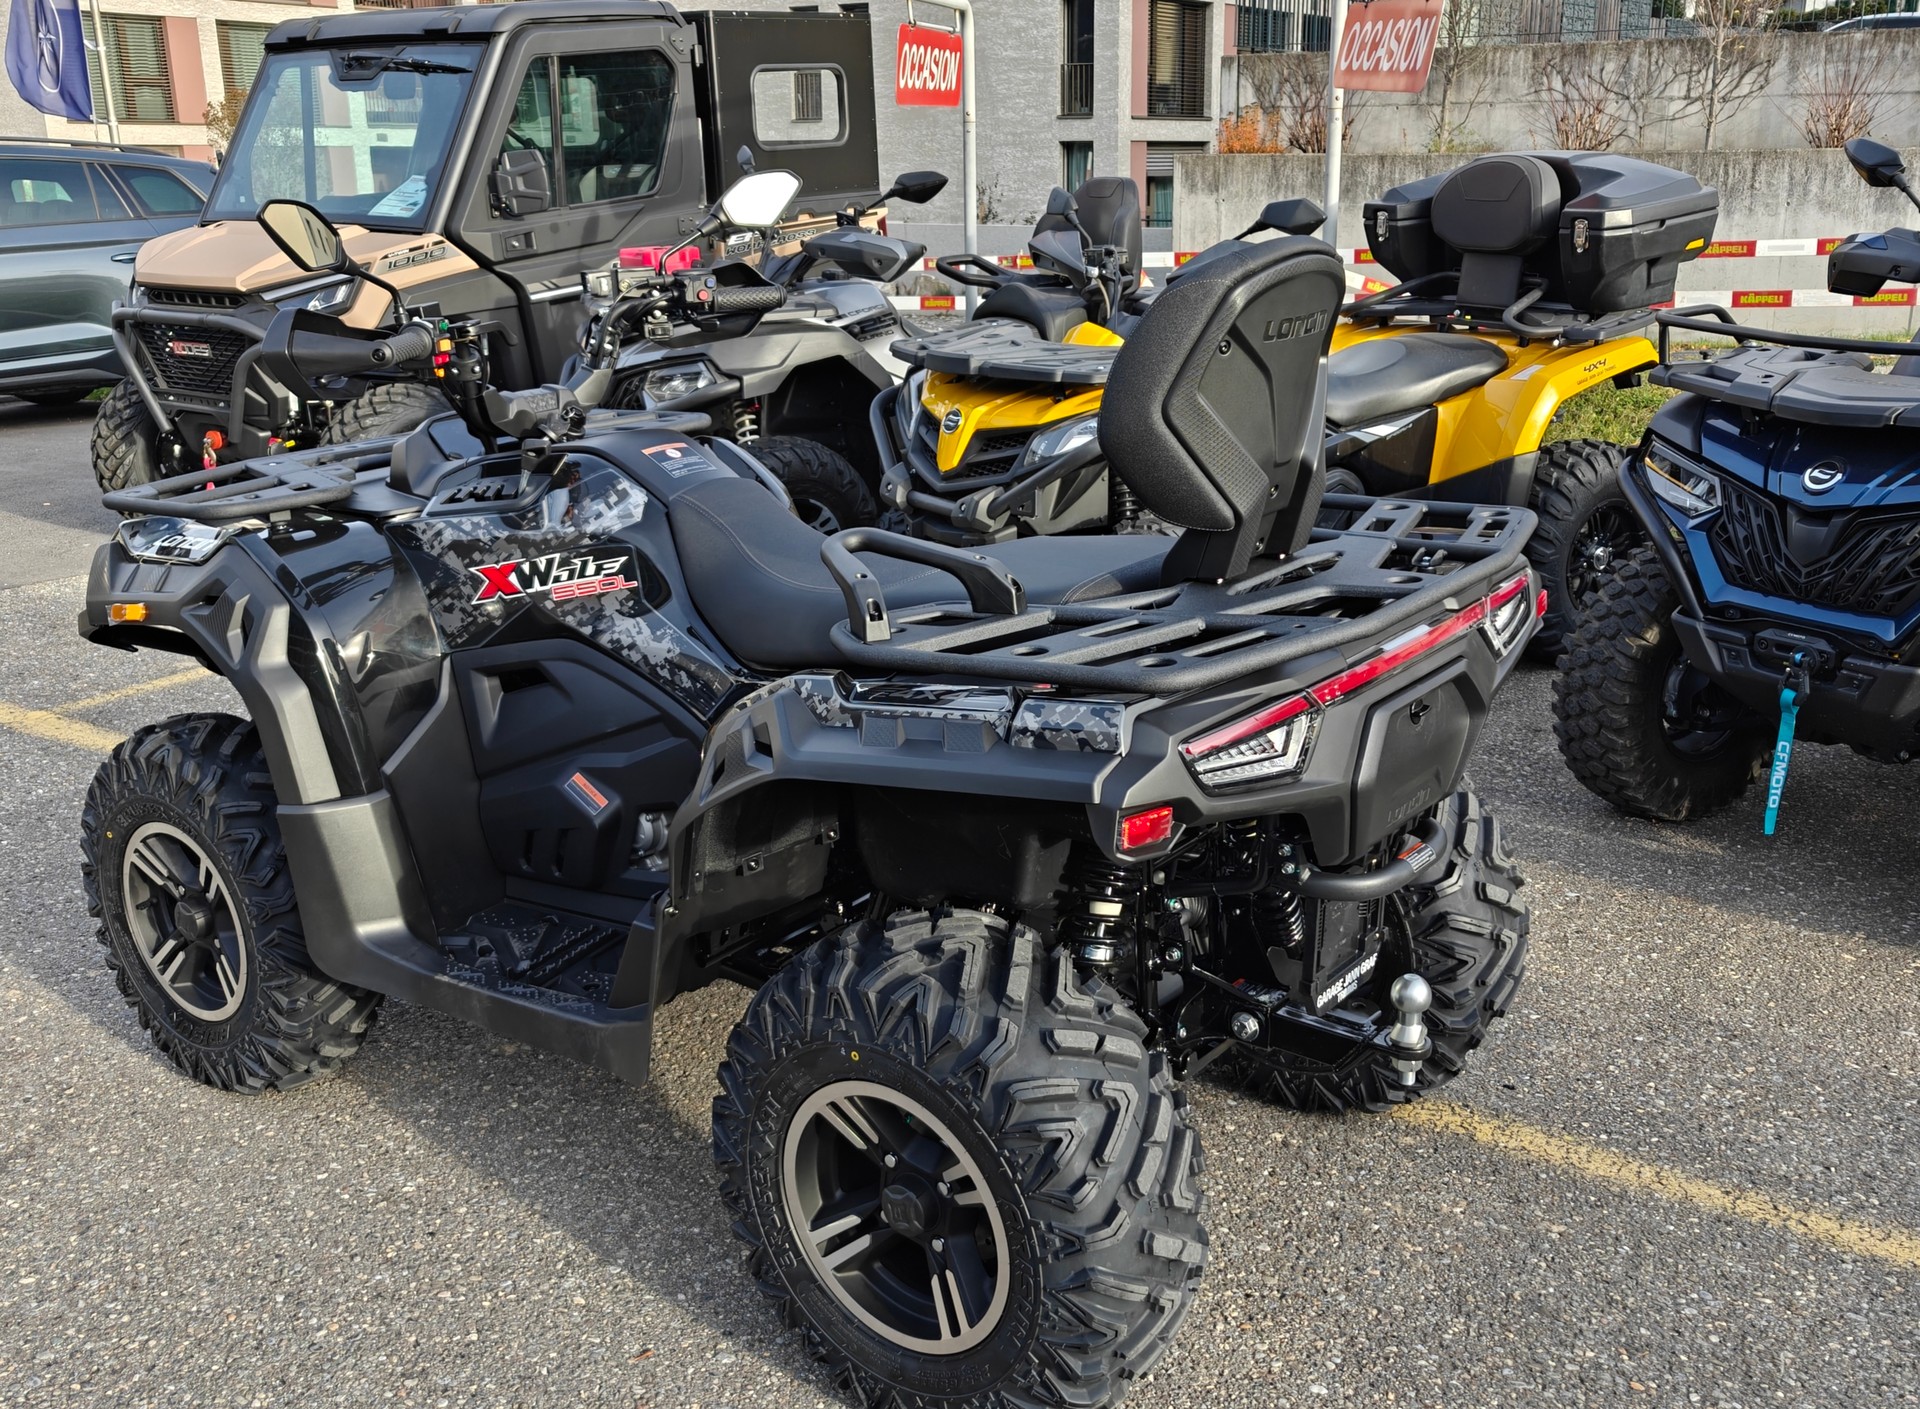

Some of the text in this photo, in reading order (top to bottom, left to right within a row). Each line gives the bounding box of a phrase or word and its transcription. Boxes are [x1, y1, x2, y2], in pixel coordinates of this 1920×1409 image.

[1340, 16, 1436, 73] OCCASION
[899, 42, 960, 92] OCCASION
[388, 247, 447, 270] 1000
[1740, 293, 1783, 303] KÄPPELI
[551, 575, 639, 601] 550L
[1769, 741, 1790, 809] CFMOTO
[1316, 977, 1344, 1008] GARAGE
